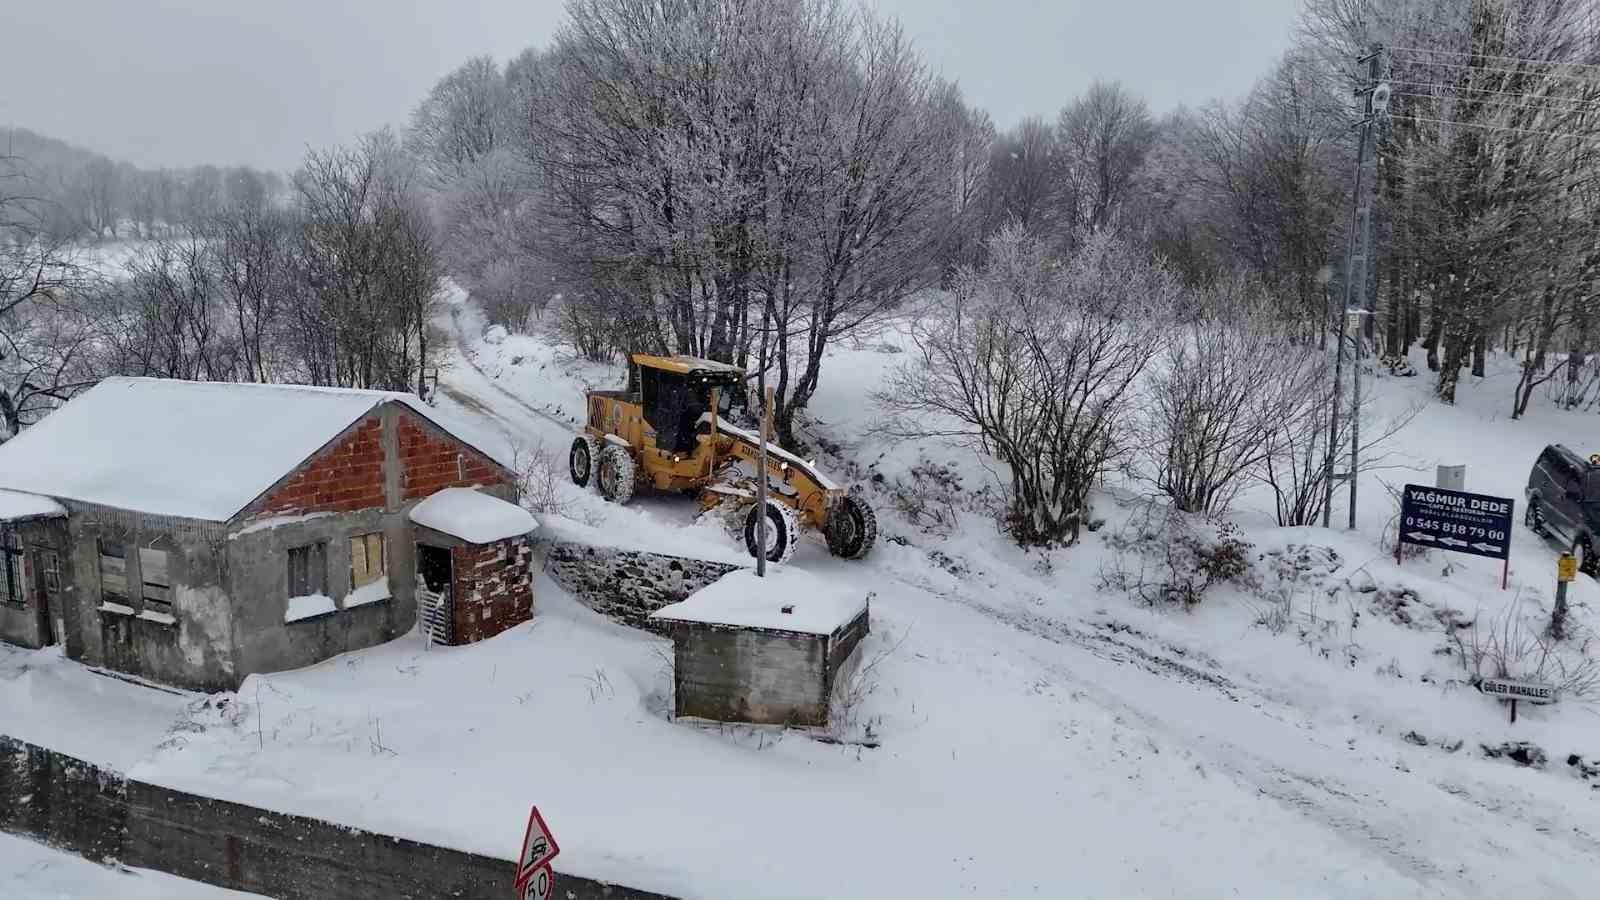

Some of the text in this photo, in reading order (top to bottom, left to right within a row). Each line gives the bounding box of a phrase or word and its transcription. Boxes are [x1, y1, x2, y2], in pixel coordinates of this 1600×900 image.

[1410, 490, 1509, 514] YAĞMUR DEDE
[1406, 516, 1414, 526] 0
[1416, 518, 1439, 530] 545
[1442, 522, 1466, 535] 818
[1469, 526, 1485, 537] 79
[1488, 529, 1505, 541] 00
[528, 871, 547, 900] 50
